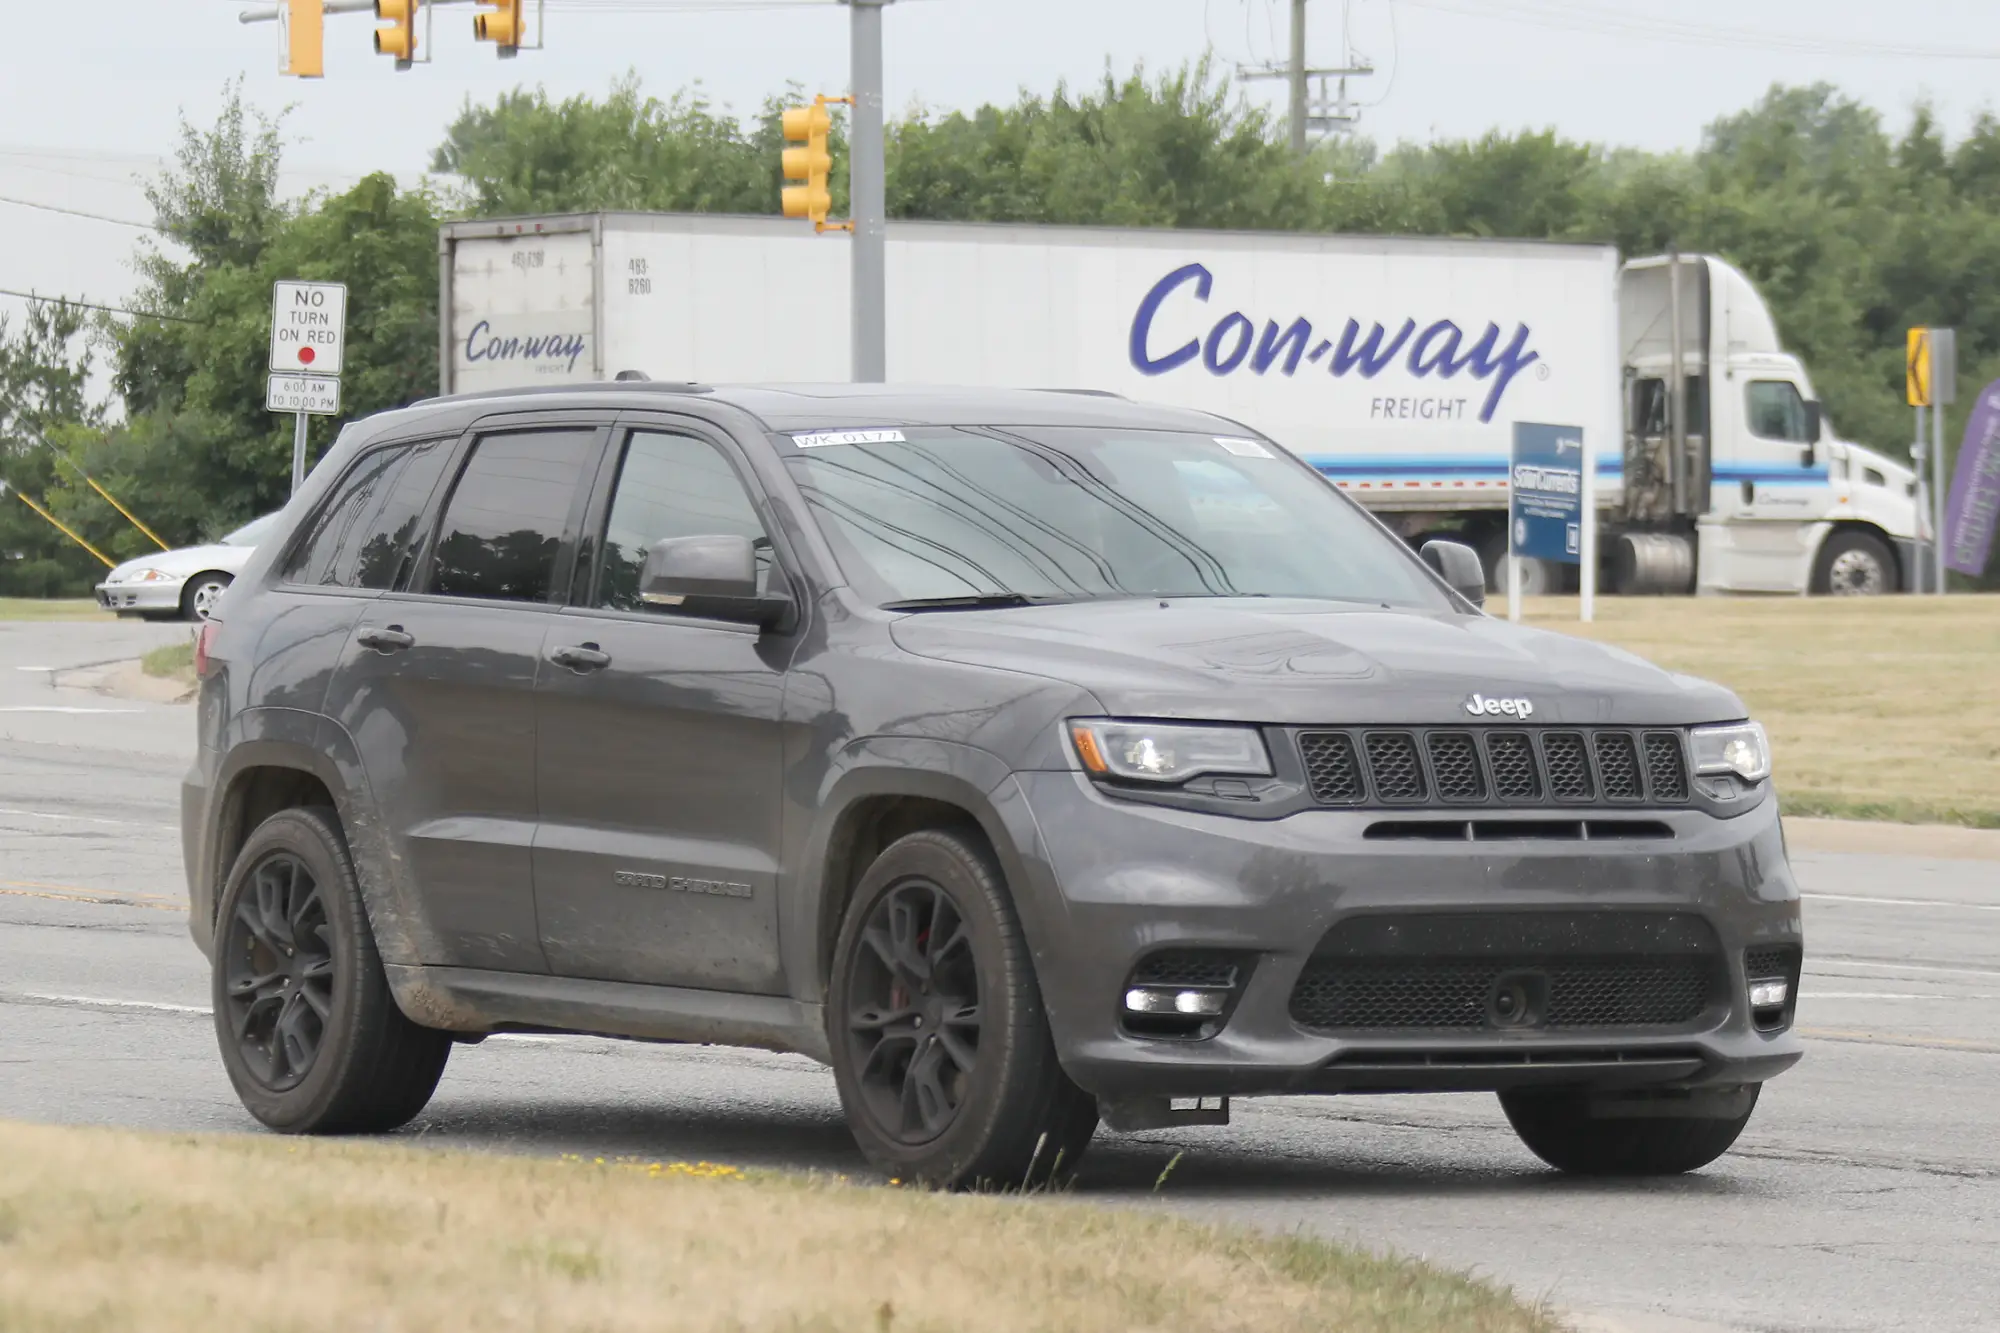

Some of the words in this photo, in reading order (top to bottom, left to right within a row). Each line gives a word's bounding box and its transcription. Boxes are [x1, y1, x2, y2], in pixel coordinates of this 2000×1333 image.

[628, 278, 651, 295] 6260
[295, 290, 324, 307] NO
[290, 311, 329, 325] TURN
[279, 328, 299, 342] ON
[307, 330, 336, 344] RED
[1129, 262, 1540, 424] Con-way
[465, 320, 585, 373] Con-way
[311, 383, 325, 393] AM
[272, 394, 284, 405] TO
[321, 398, 334, 409] PM
[1370, 397, 1467, 420] FREIGHT
[797, 435, 834, 446] WK
[1465, 693, 1533, 720] Jeep
[614, 870, 666, 889] GRAND
